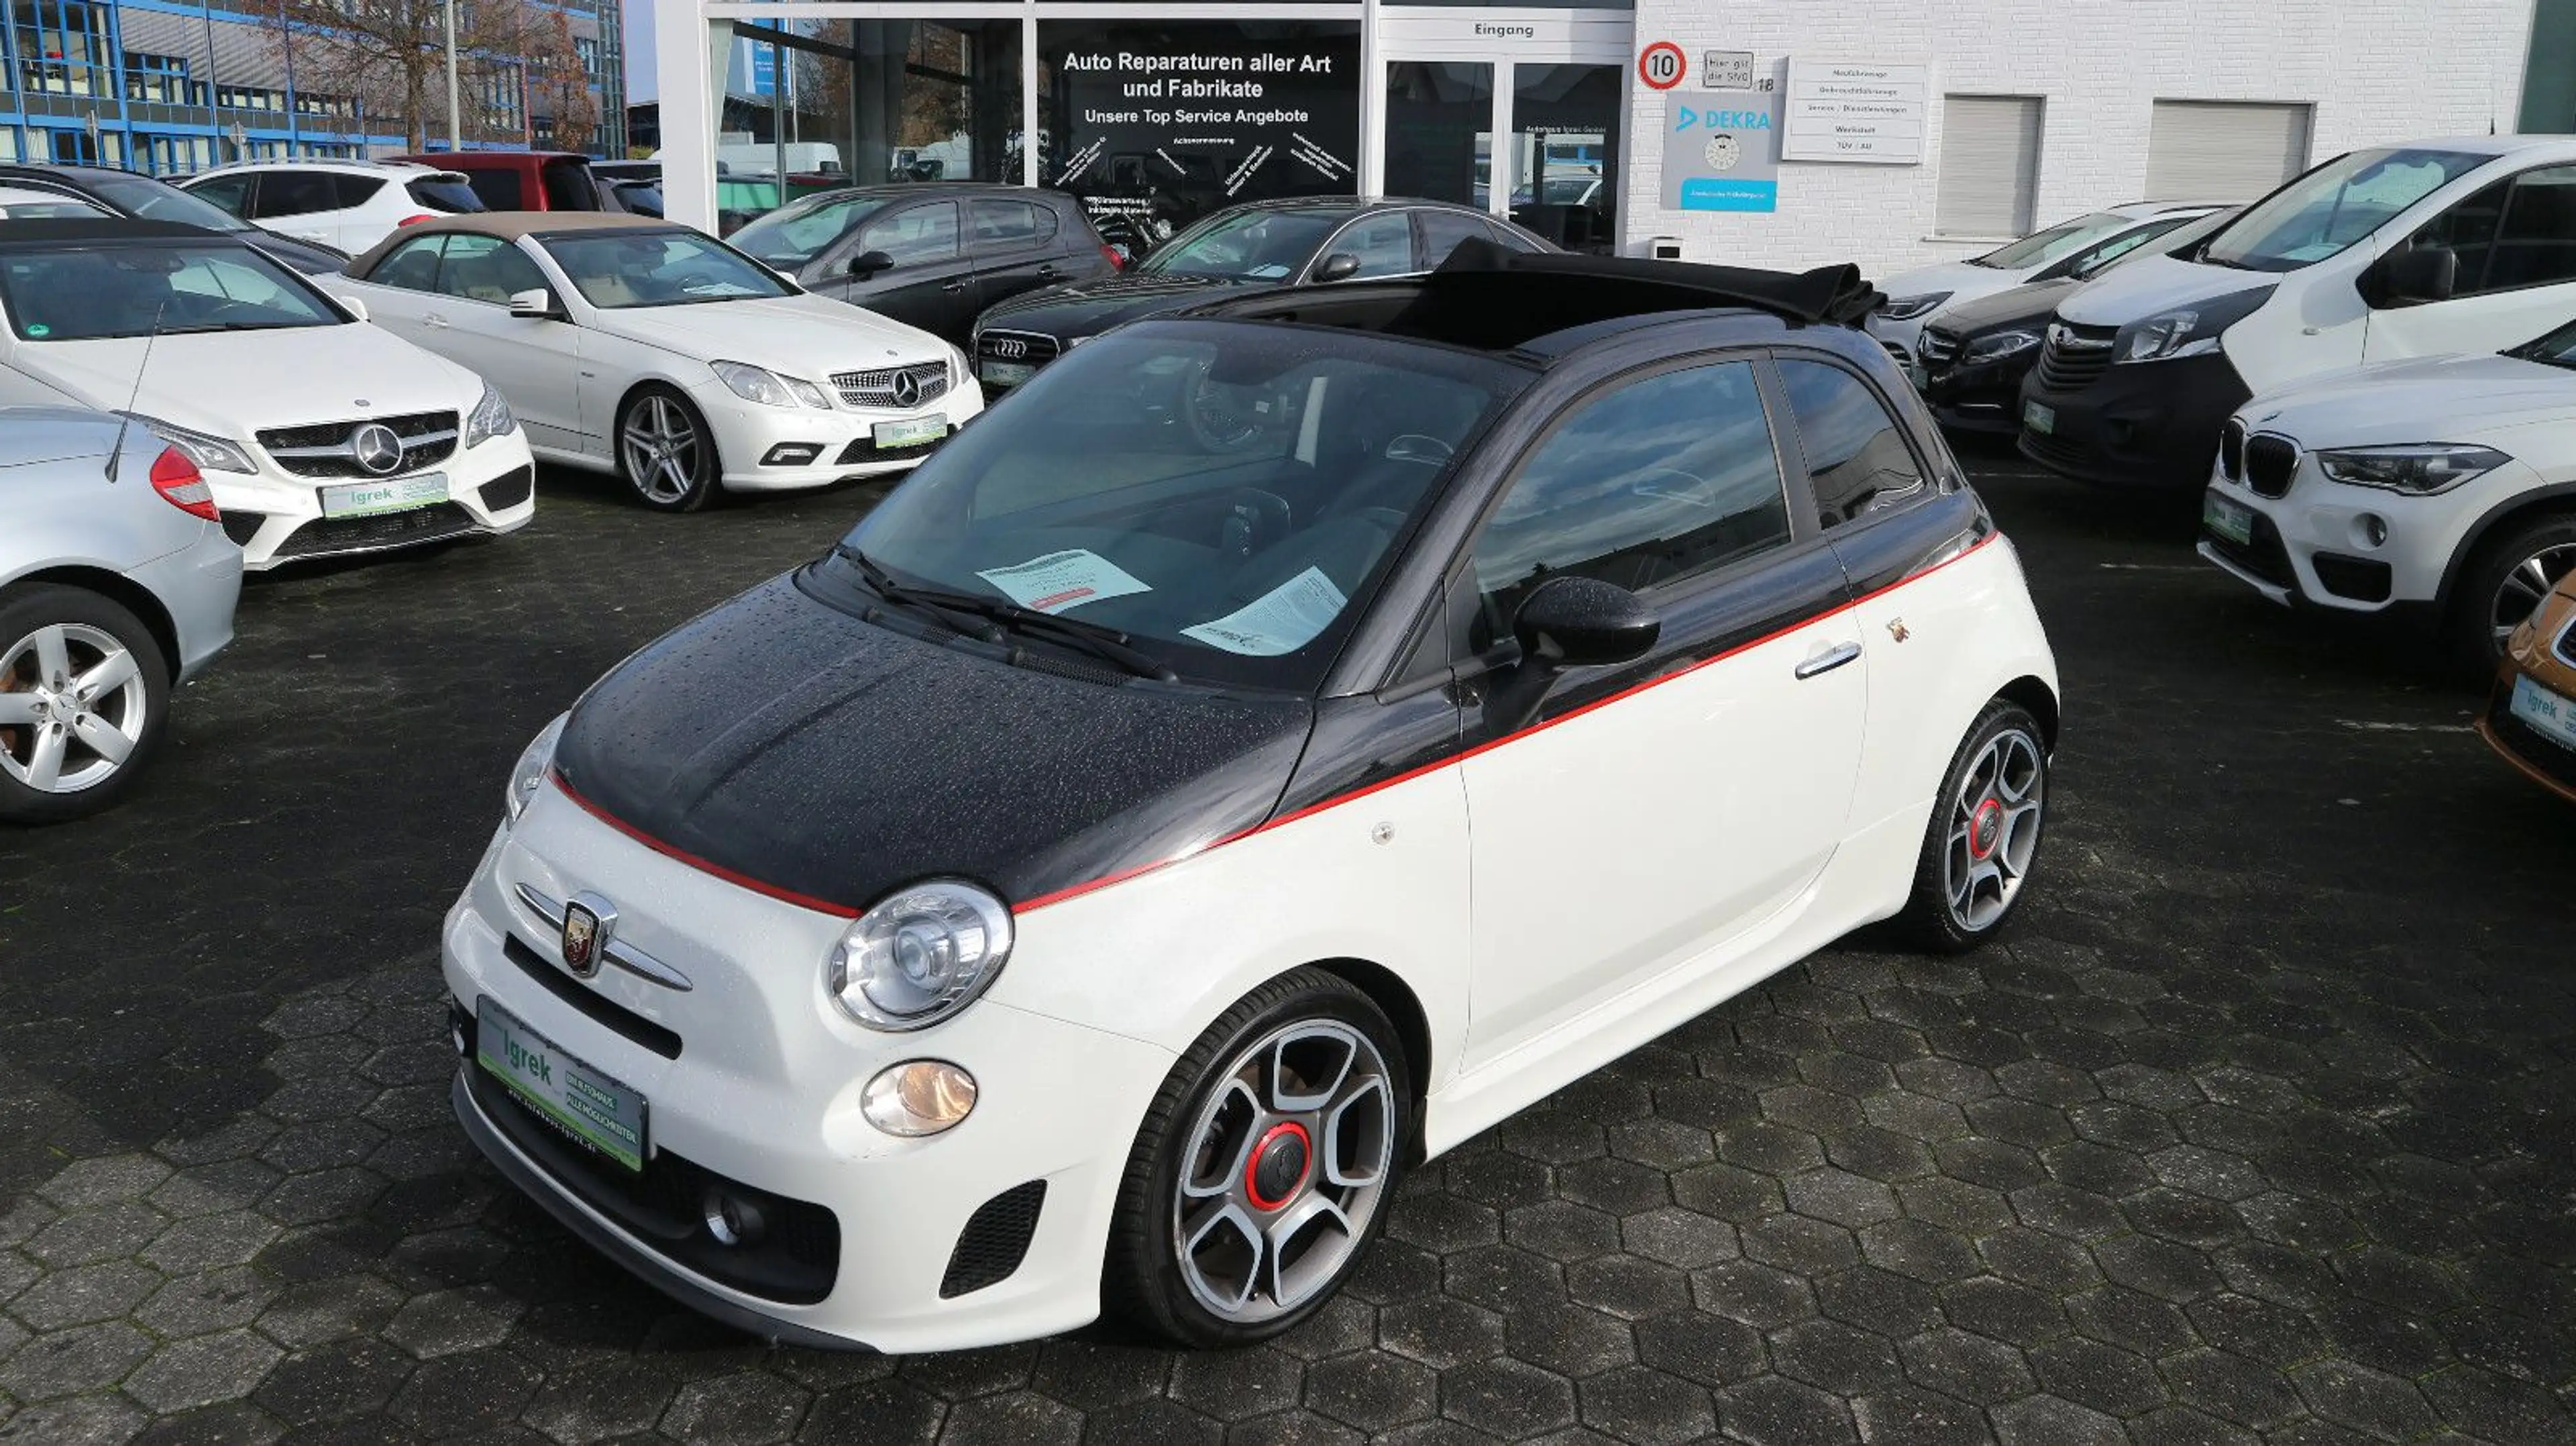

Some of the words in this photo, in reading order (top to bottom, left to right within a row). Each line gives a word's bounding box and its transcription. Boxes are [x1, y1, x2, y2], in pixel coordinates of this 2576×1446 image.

[1475, 23, 1534, 38] Eingang
[1064, 52, 1112, 70] Auto
[1118, 52, 1243, 74] Reparaturen
[1249, 53, 1295, 72] aller
[1299, 54, 1331, 73] Art
[1652, 54, 1674, 76] 10
[1124, 79, 1162, 97] und
[1169, 79, 1263, 98] Fabrikate
[1085, 109, 1138, 123] Unsere
[1142, 109, 1171, 126] Top
[1175, 109, 1231, 123] Service
[1234, 109, 1308, 126] Angebote
[1706, 110, 1771, 130] DEKRA
[351, 488, 392, 504] Igrek
[2528, 689, 2558, 719] Igrek
[504, 1028, 551, 1087] Igrek
